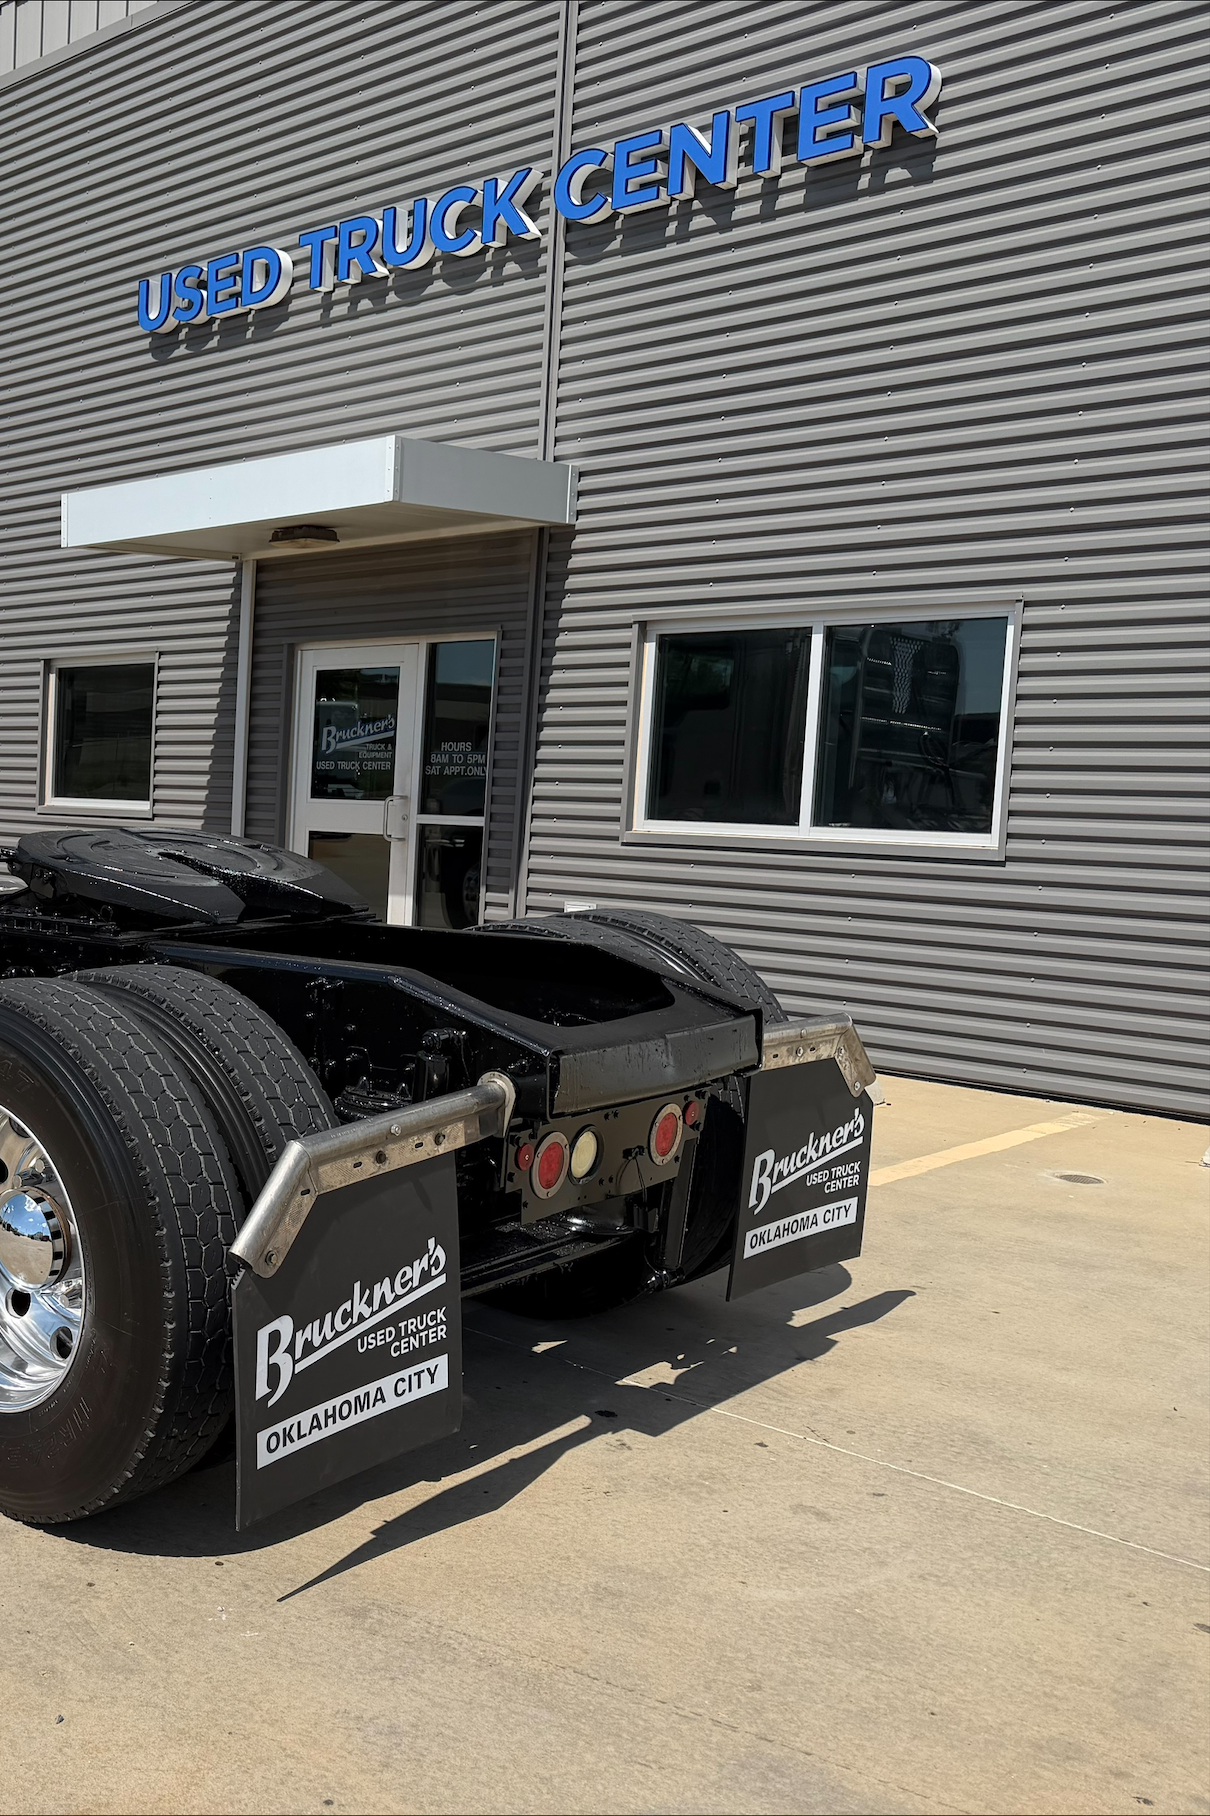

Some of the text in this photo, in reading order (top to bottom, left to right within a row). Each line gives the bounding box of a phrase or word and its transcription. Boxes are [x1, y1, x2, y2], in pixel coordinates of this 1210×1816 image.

[138, 55, 939, 333] USED TRUCK CENTER
[321, 714, 395, 754] Bruckner's
[366, 743, 385, 751] TRUCK
[441, 742, 472, 752] HOURS
[316, 760, 392, 770] USED TRUCK CENTER
[359, 751, 392, 759] EQUIPMENT
[430, 753, 486, 764] 8AM TO 5PM
[425, 765, 441, 776] SAT
[748, 1107, 865, 1216] Bruckner's
[806, 1161, 861, 1187] USED TRUCK
[824, 1174, 859, 1194] CENTER
[749, 1203, 853, 1250] OKLAHOMA CITY
[255, 1237, 447, 1408] Bruckner's
[357, 1306, 447, 1353] USED TRUCK
[390, 1324, 447, 1358] CENTER
[265, 1363, 441, 1454] OKLAHOMA CITY
